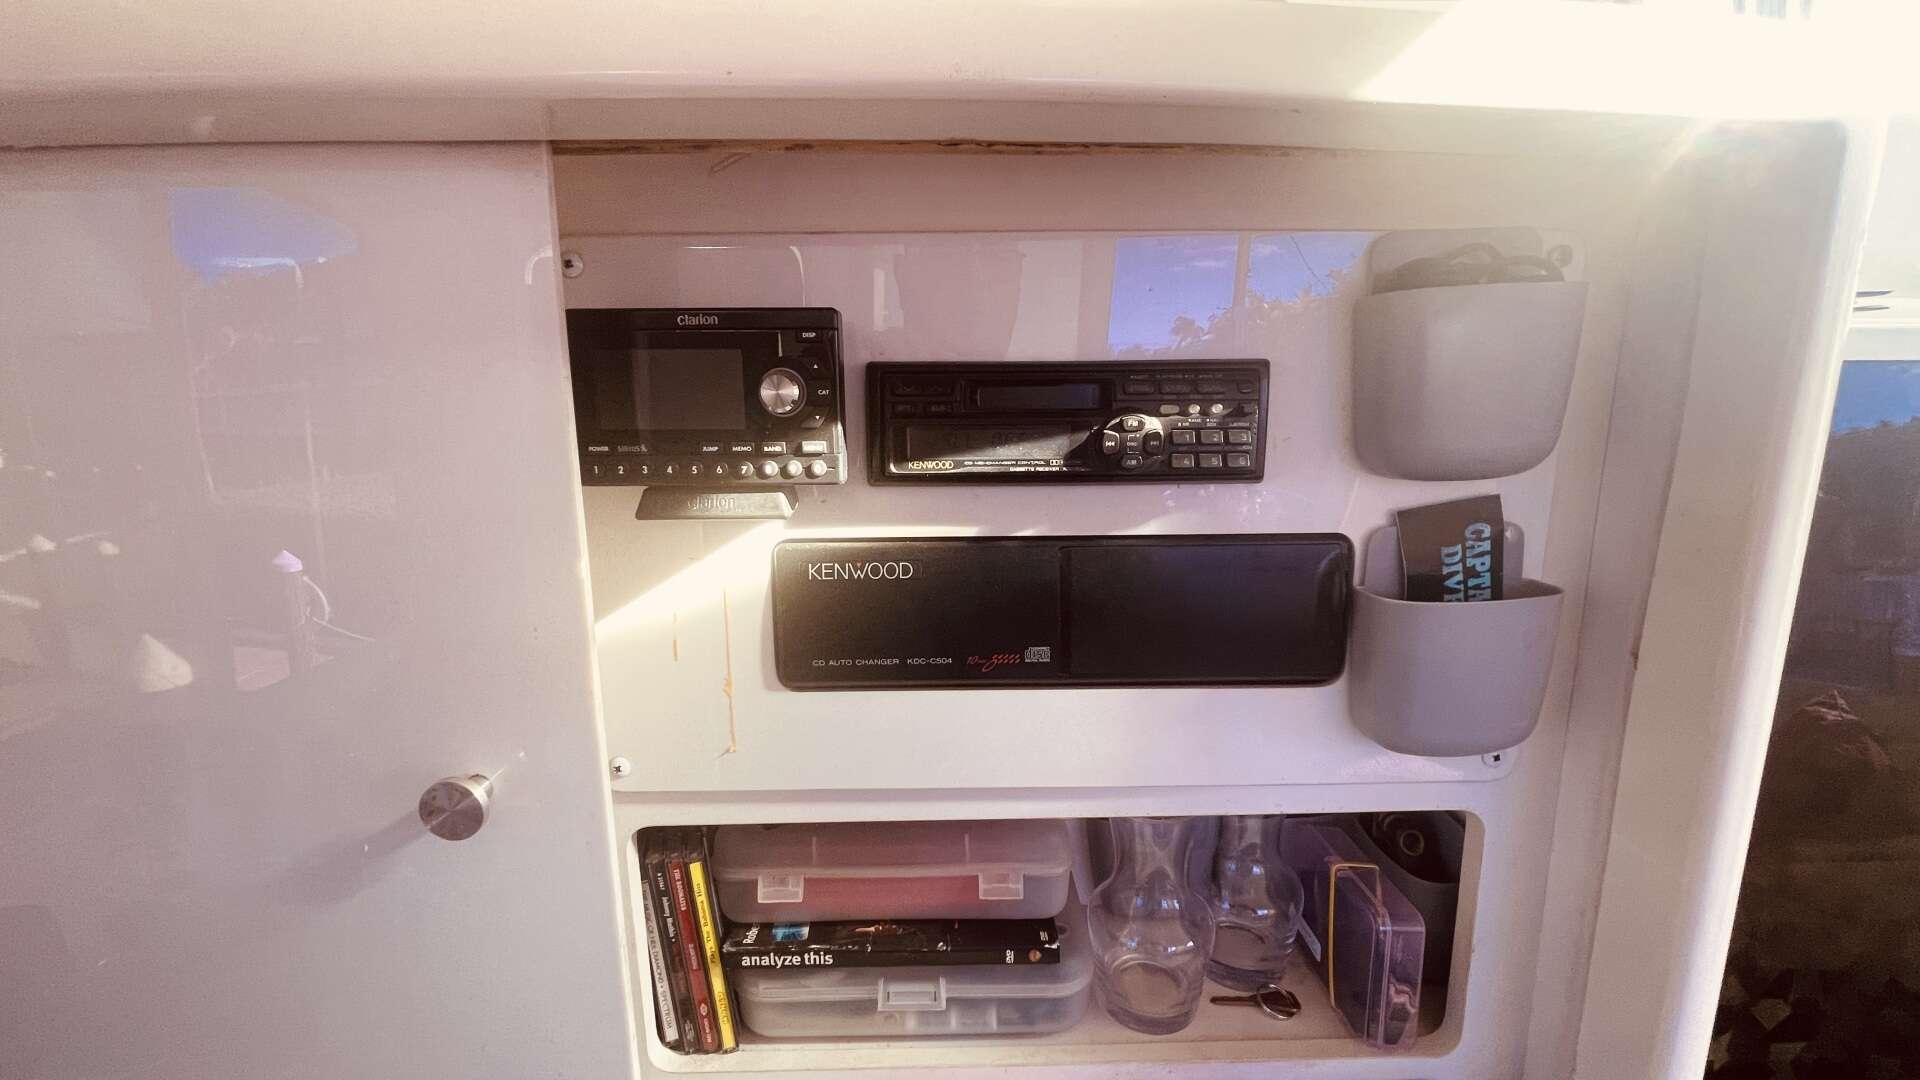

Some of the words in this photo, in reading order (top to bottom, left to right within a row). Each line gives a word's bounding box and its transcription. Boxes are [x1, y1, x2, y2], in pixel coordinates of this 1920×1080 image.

[594, 465, 598, 474] 1
[618, 465, 624, 474] 2
[642, 465, 648, 474] 3
[666, 465, 672, 474] 4
[691, 465, 698, 474] 5
[716, 465, 722, 474] 6
[740, 465, 747, 474] 7
[908, 460, 954, 470] KENWOOD
[808, 562, 914, 580] KENWOOD
[742, 952, 802, 968] analyze
[804, 952, 834, 965] this
